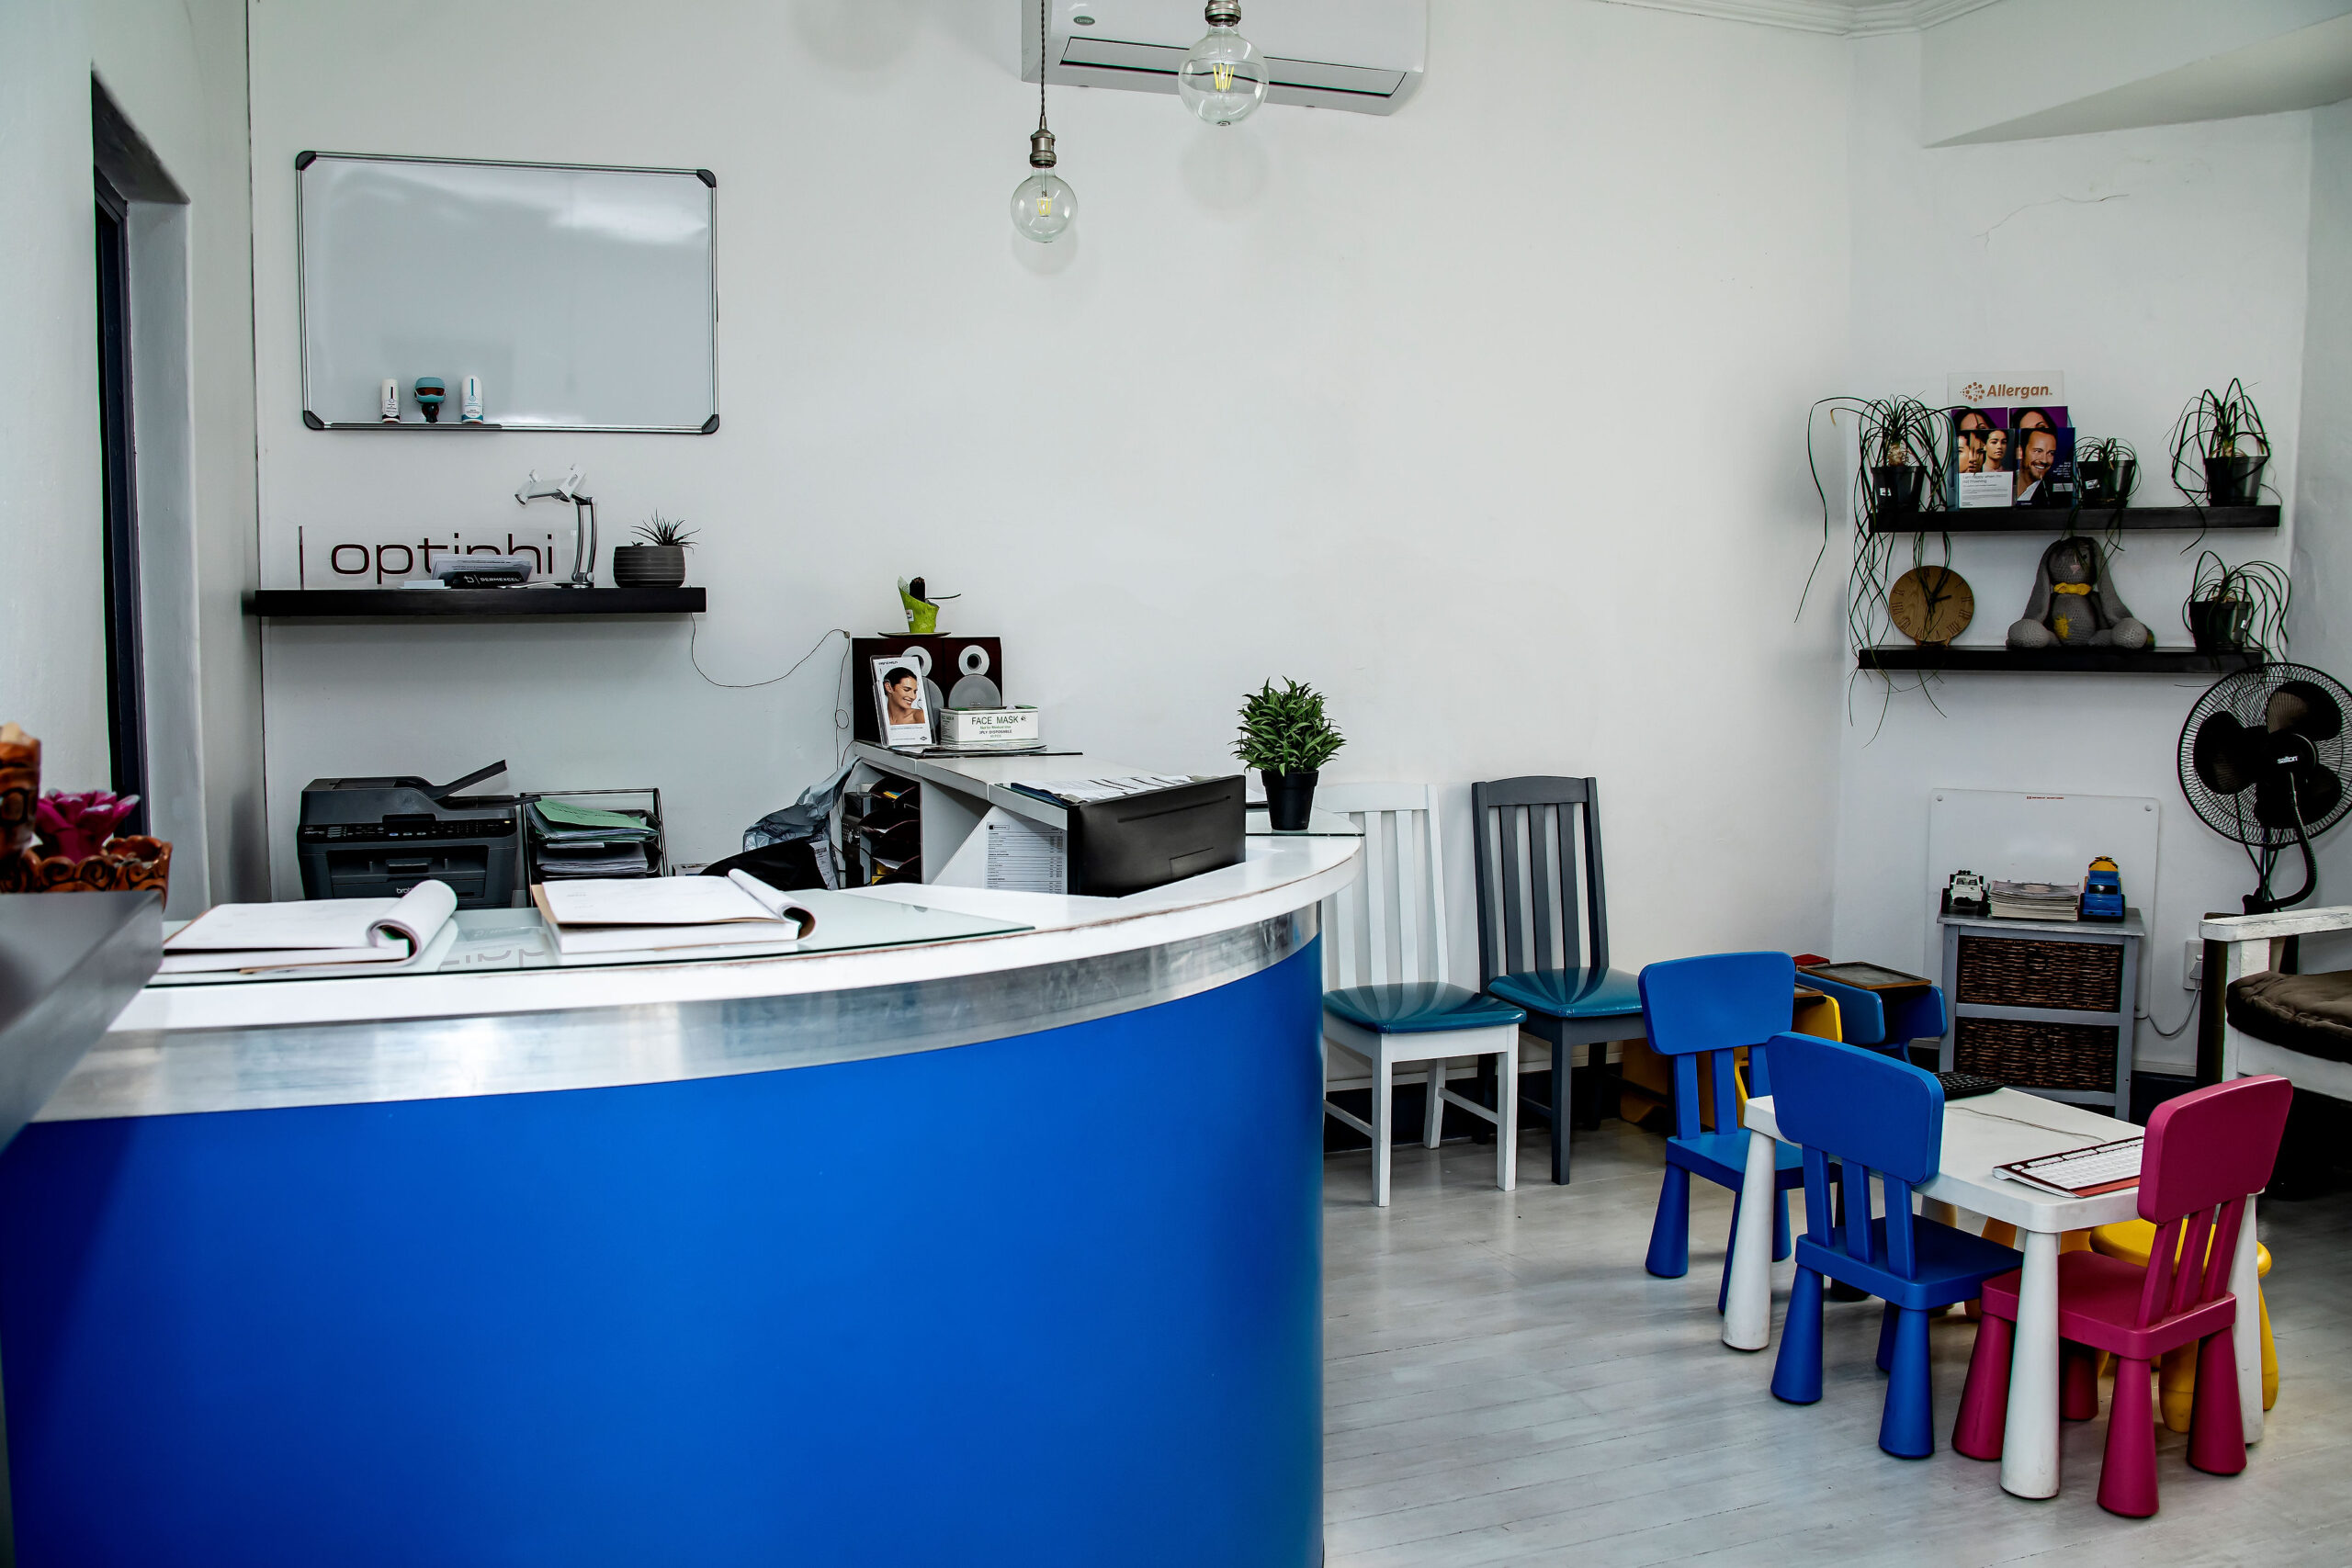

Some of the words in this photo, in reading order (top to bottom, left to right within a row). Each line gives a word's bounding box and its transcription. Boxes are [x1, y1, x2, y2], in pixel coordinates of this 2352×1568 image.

[330, 532, 554, 585] optihi
[971, 716, 992, 725] FACE
[997, 716, 1019, 724] MASK
